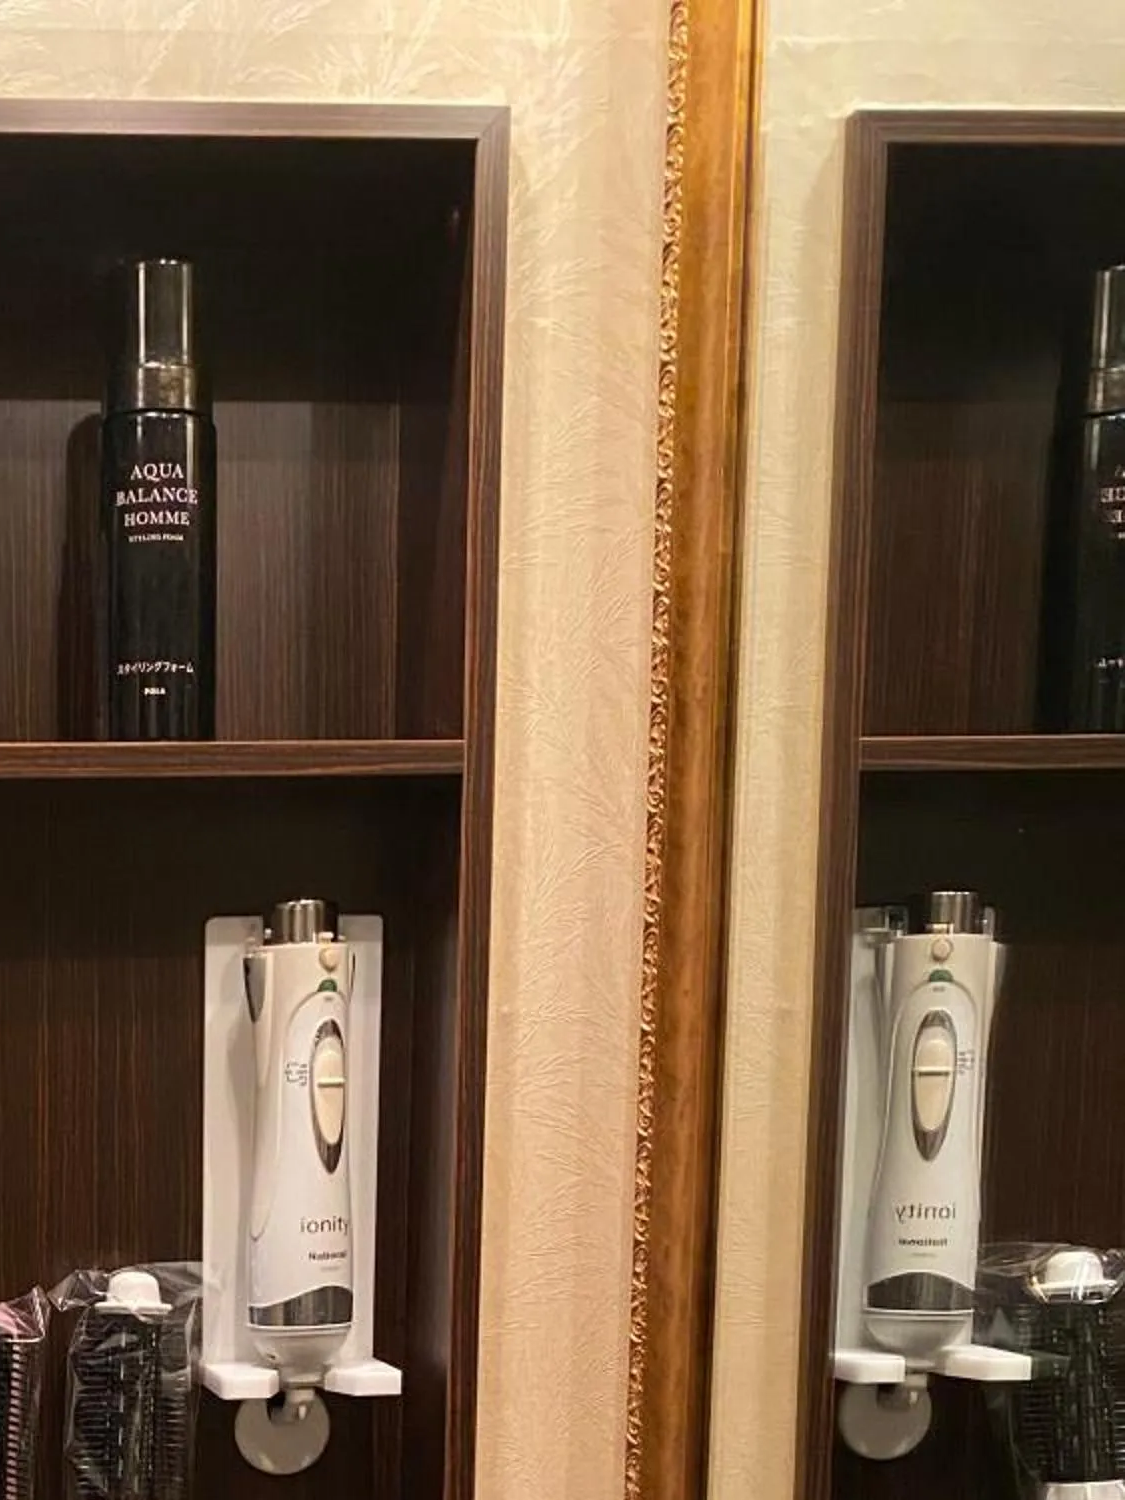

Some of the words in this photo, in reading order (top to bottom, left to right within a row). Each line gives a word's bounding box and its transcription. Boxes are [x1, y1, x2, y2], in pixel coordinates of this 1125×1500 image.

[130, 463, 184, 482] AQUA
[115, 487, 198, 507] BALANCE
[124, 510, 190, 528] HOMME
[300, 1215, 348, 1237] ionity
